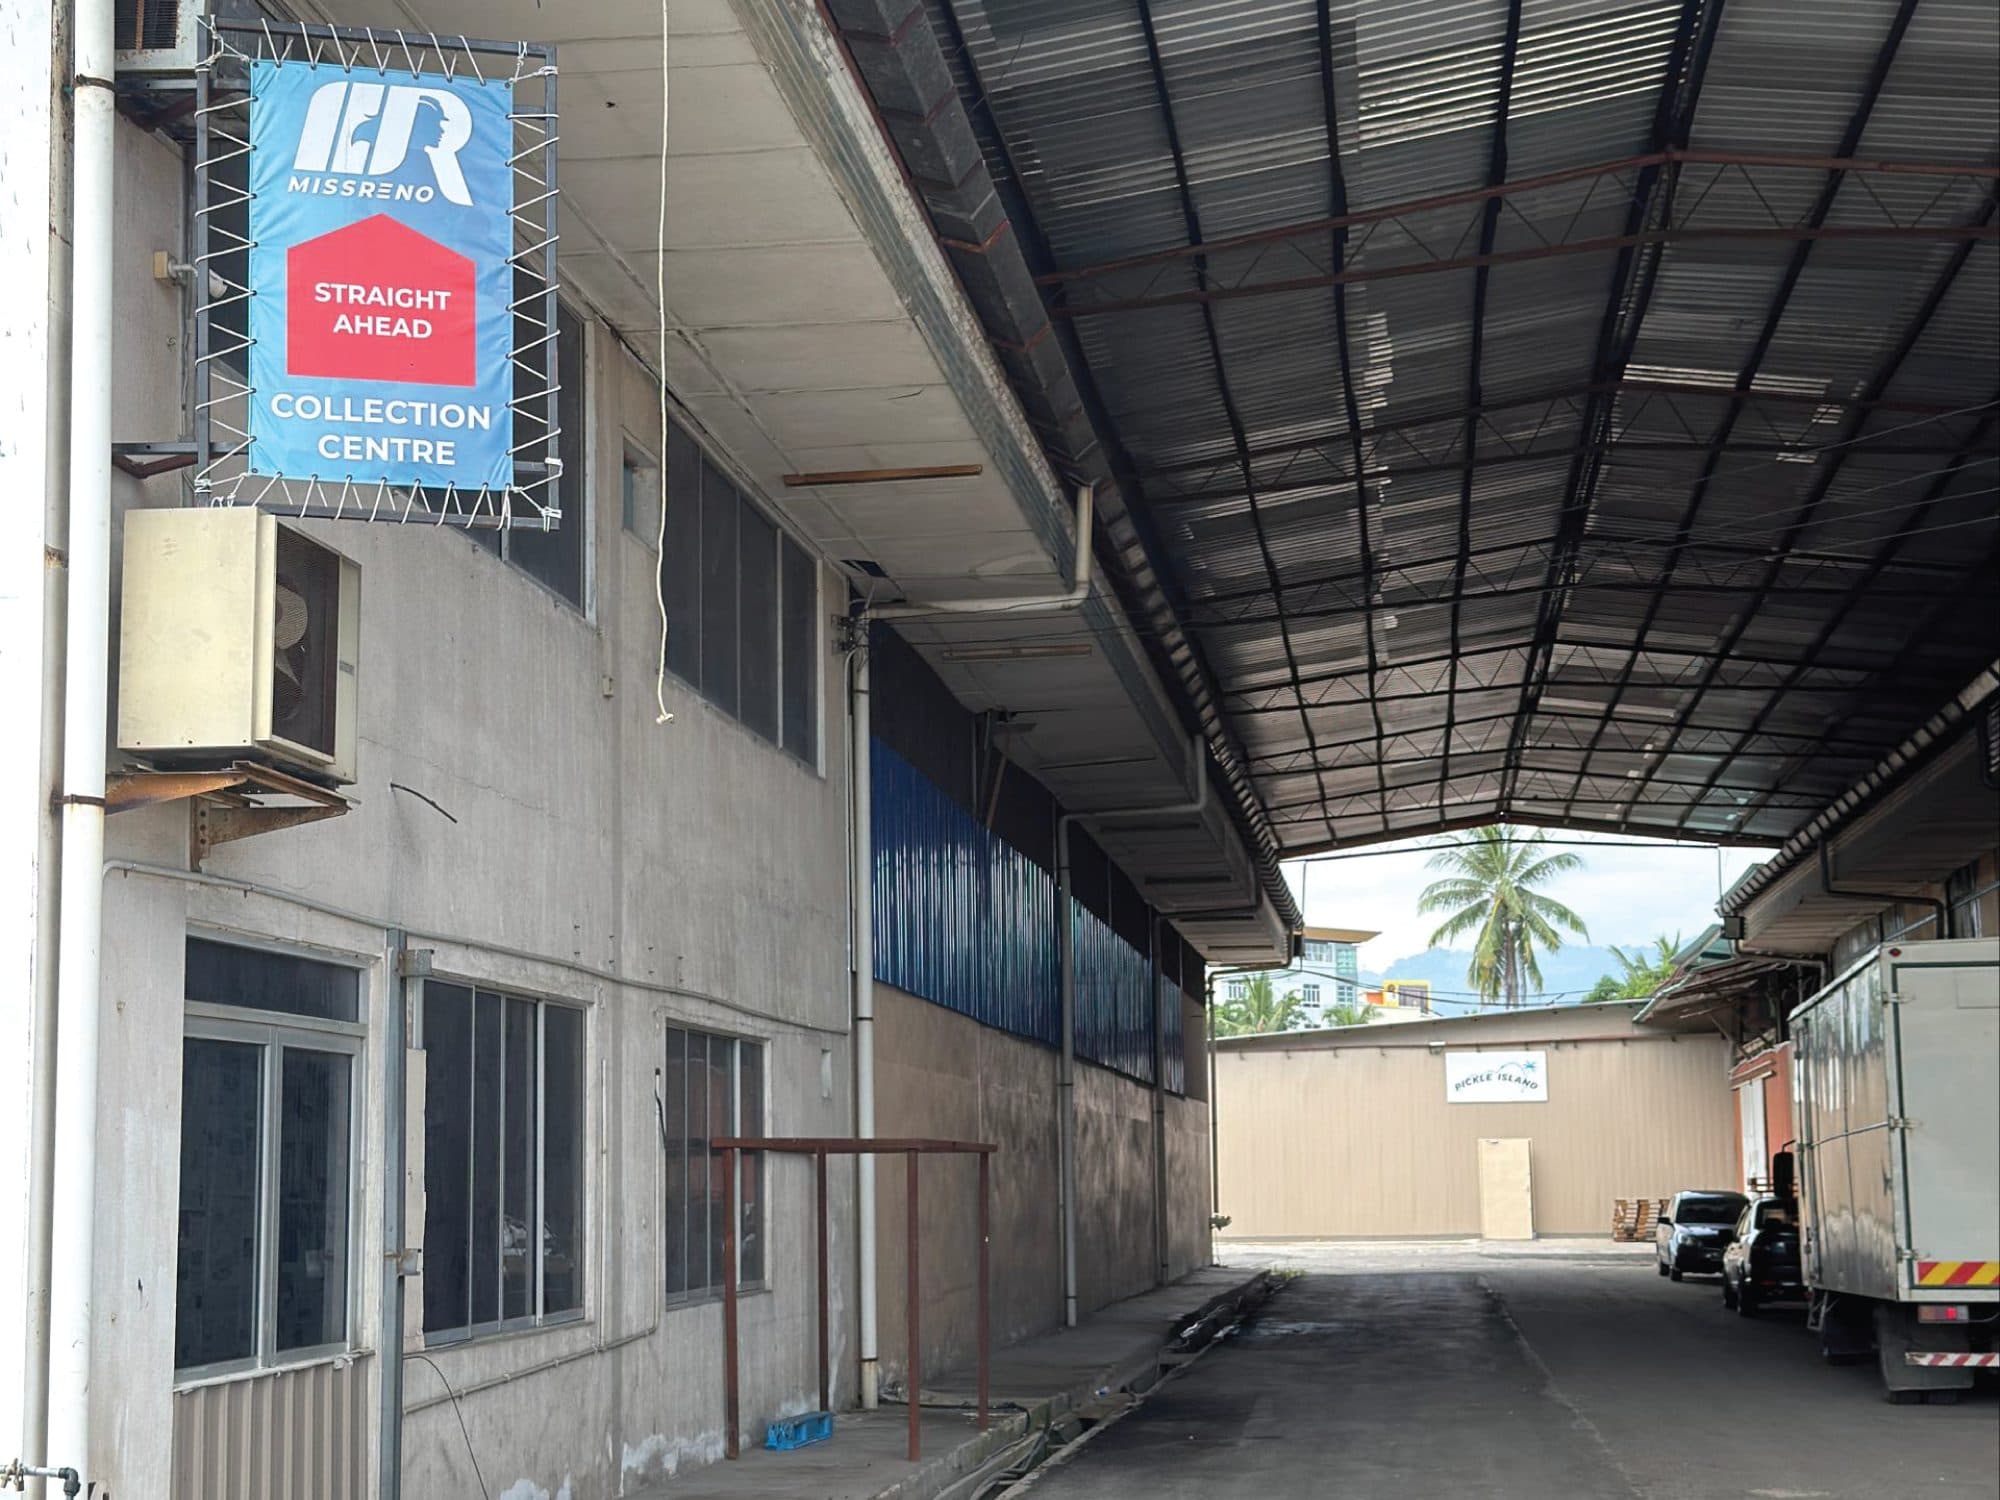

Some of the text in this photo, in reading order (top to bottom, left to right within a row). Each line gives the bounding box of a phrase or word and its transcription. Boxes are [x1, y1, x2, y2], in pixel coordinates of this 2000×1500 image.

[287, 176, 434, 203] MISSRENO
[314, 282, 452, 311] STRAIGHT
[332, 314, 433, 339] AHEAD
[270, 393, 491, 431] COLLECTION
[318, 435, 456, 466] CENTRE
[1454, 1073, 1539, 1091] PICKLE ISLAND
